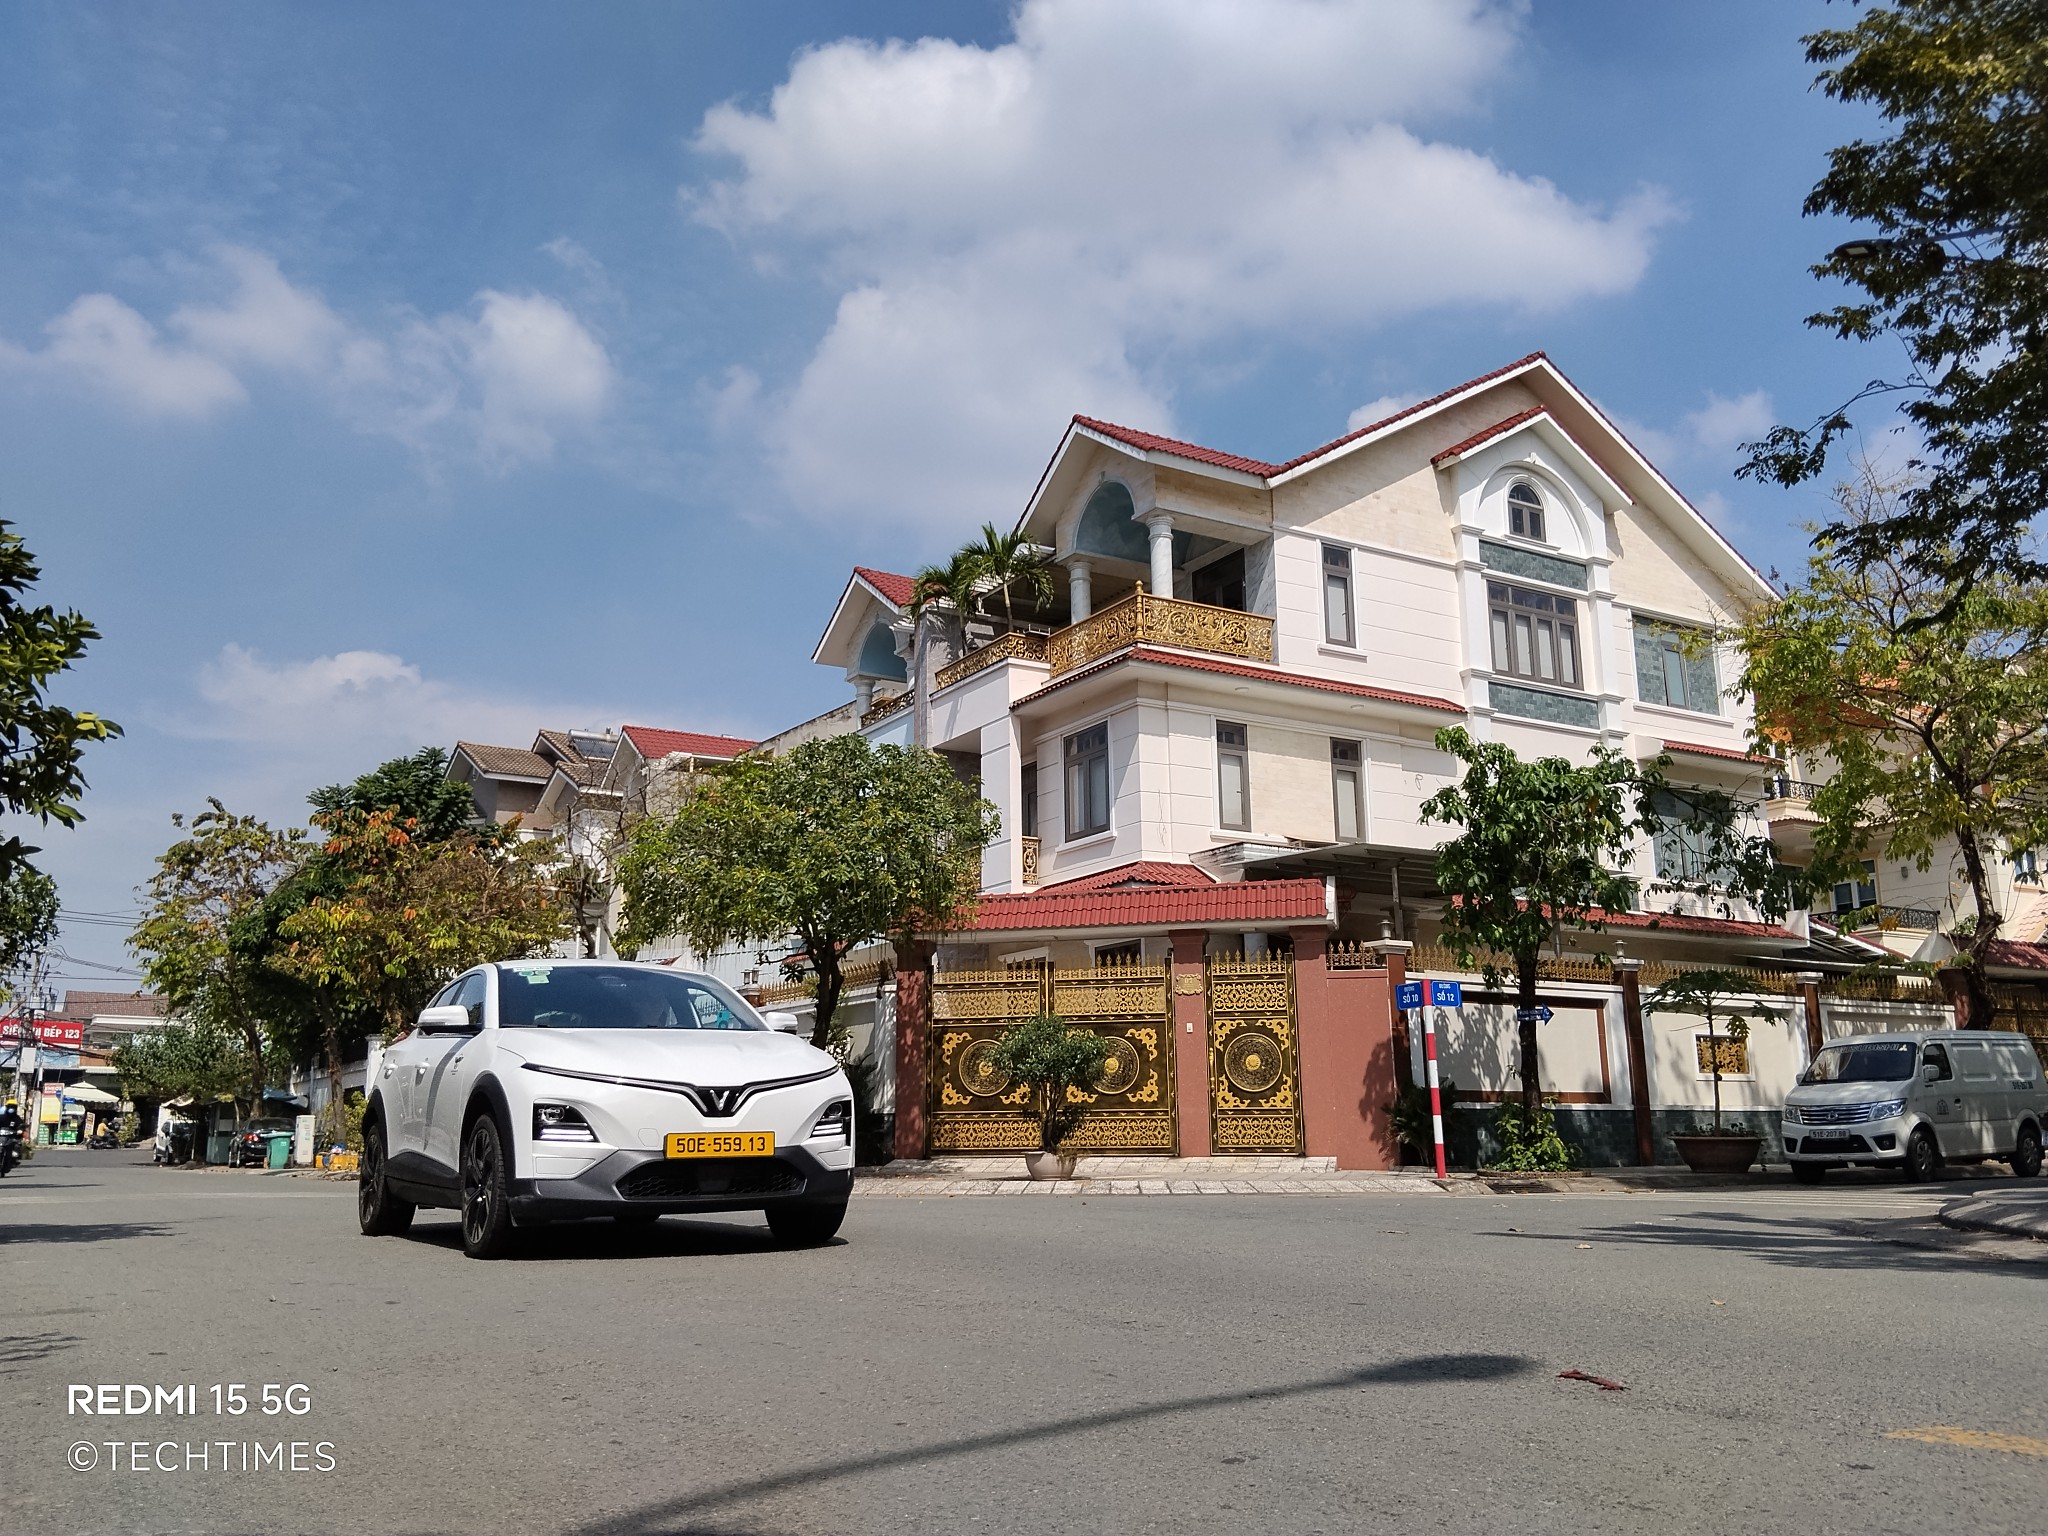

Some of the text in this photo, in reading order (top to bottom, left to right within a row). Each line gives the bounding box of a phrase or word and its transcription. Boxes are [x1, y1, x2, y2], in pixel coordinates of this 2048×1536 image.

[1402, 992, 1419, 1004] SỐ 10
[1437, 990, 1455, 1002] SỐ 12
[43, 1025, 62, 1038] BẾP
[64, 1029, 80, 1039] 123
[676, 1136, 766, 1153] 50E-559.13
